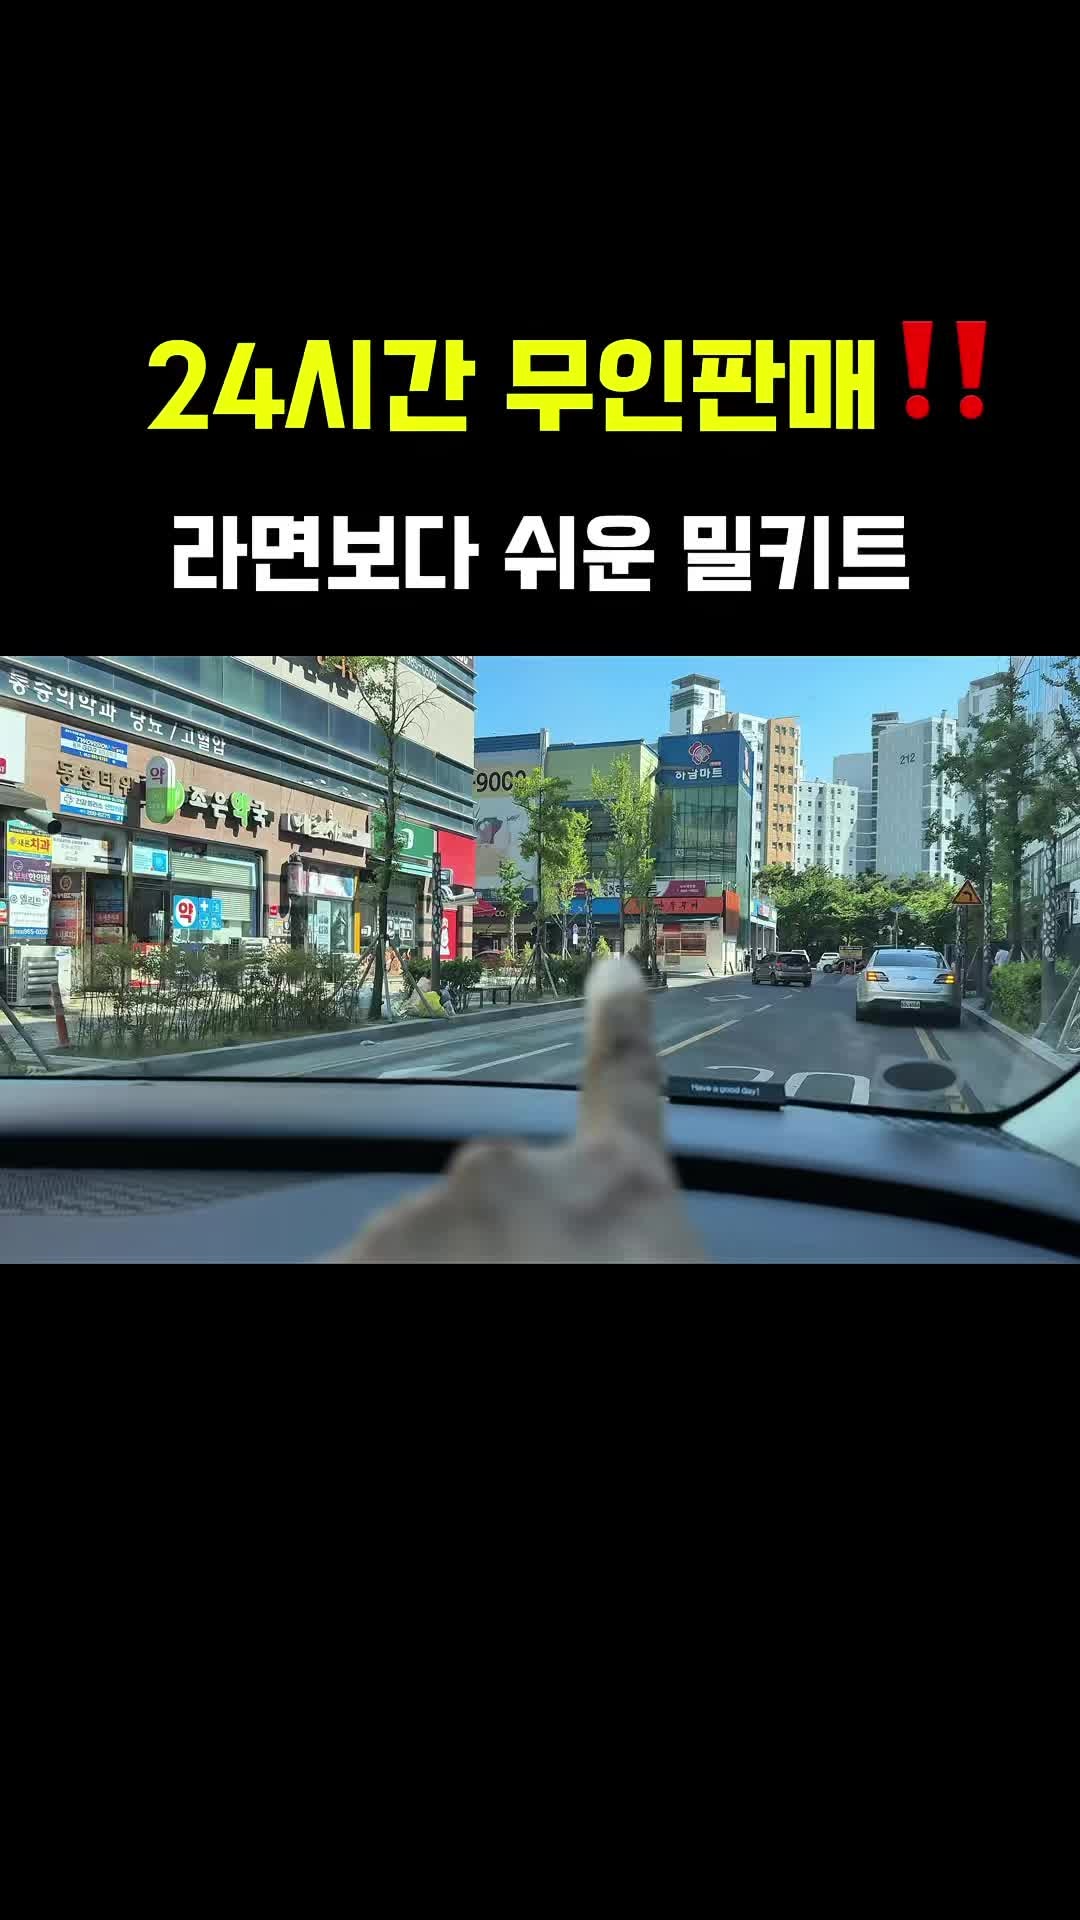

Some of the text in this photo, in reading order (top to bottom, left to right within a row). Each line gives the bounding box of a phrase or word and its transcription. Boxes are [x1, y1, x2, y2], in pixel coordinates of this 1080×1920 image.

[8, 669, 117, 723] 통증의학과
[129, 707, 164, 736] 당뇨
[181, 726, 226, 756] 고혈압
[899, 753, 916, 766] 212
[150, 767, 166, 785] 약
[675, 767, 723, 780] 하남마트
[188, 785, 269, 828] 조은약국
[178, 902, 194, 924] 약
[720, 1086, 740, 1095] good
